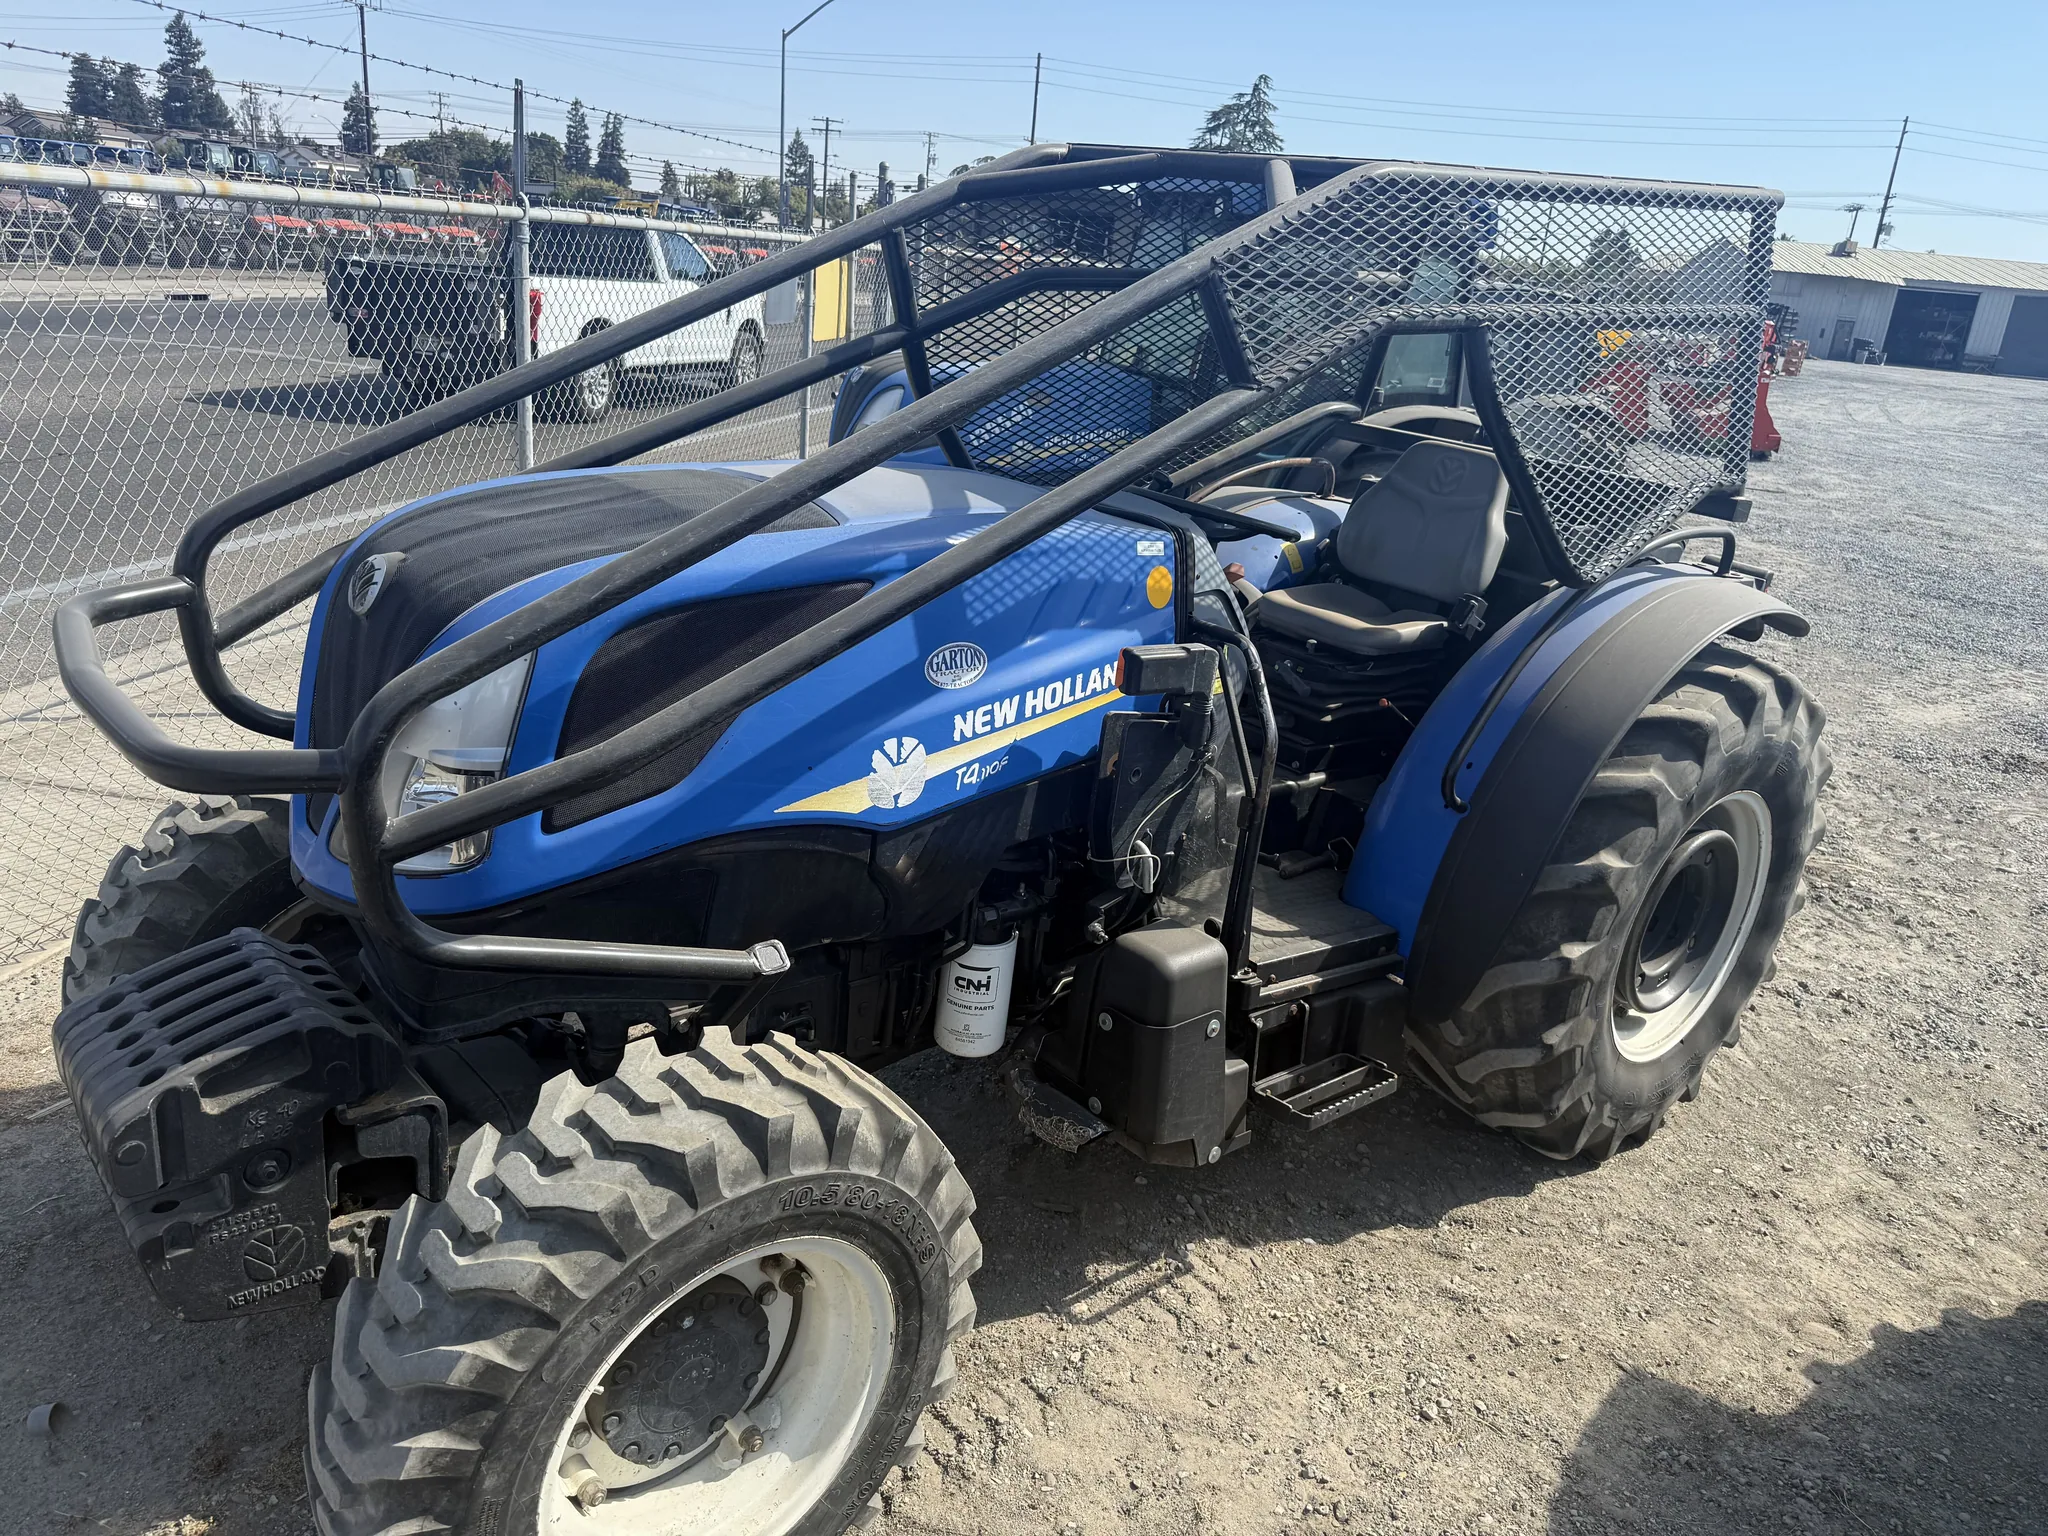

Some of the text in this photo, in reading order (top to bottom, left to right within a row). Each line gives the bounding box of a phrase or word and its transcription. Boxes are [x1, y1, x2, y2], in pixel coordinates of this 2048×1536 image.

[929, 648, 982, 673] GARTON
[934, 666, 980, 678] TRACTOR
[953, 660, 1118, 742] NEW HOLLAN
[953, 986, 990, 996] INDUSTRIAL
[946, 998, 973, 1011] GENUINE
[276, 1099, 299, 1117] 40
[843, 1392, 922, 1520] SAMSON
